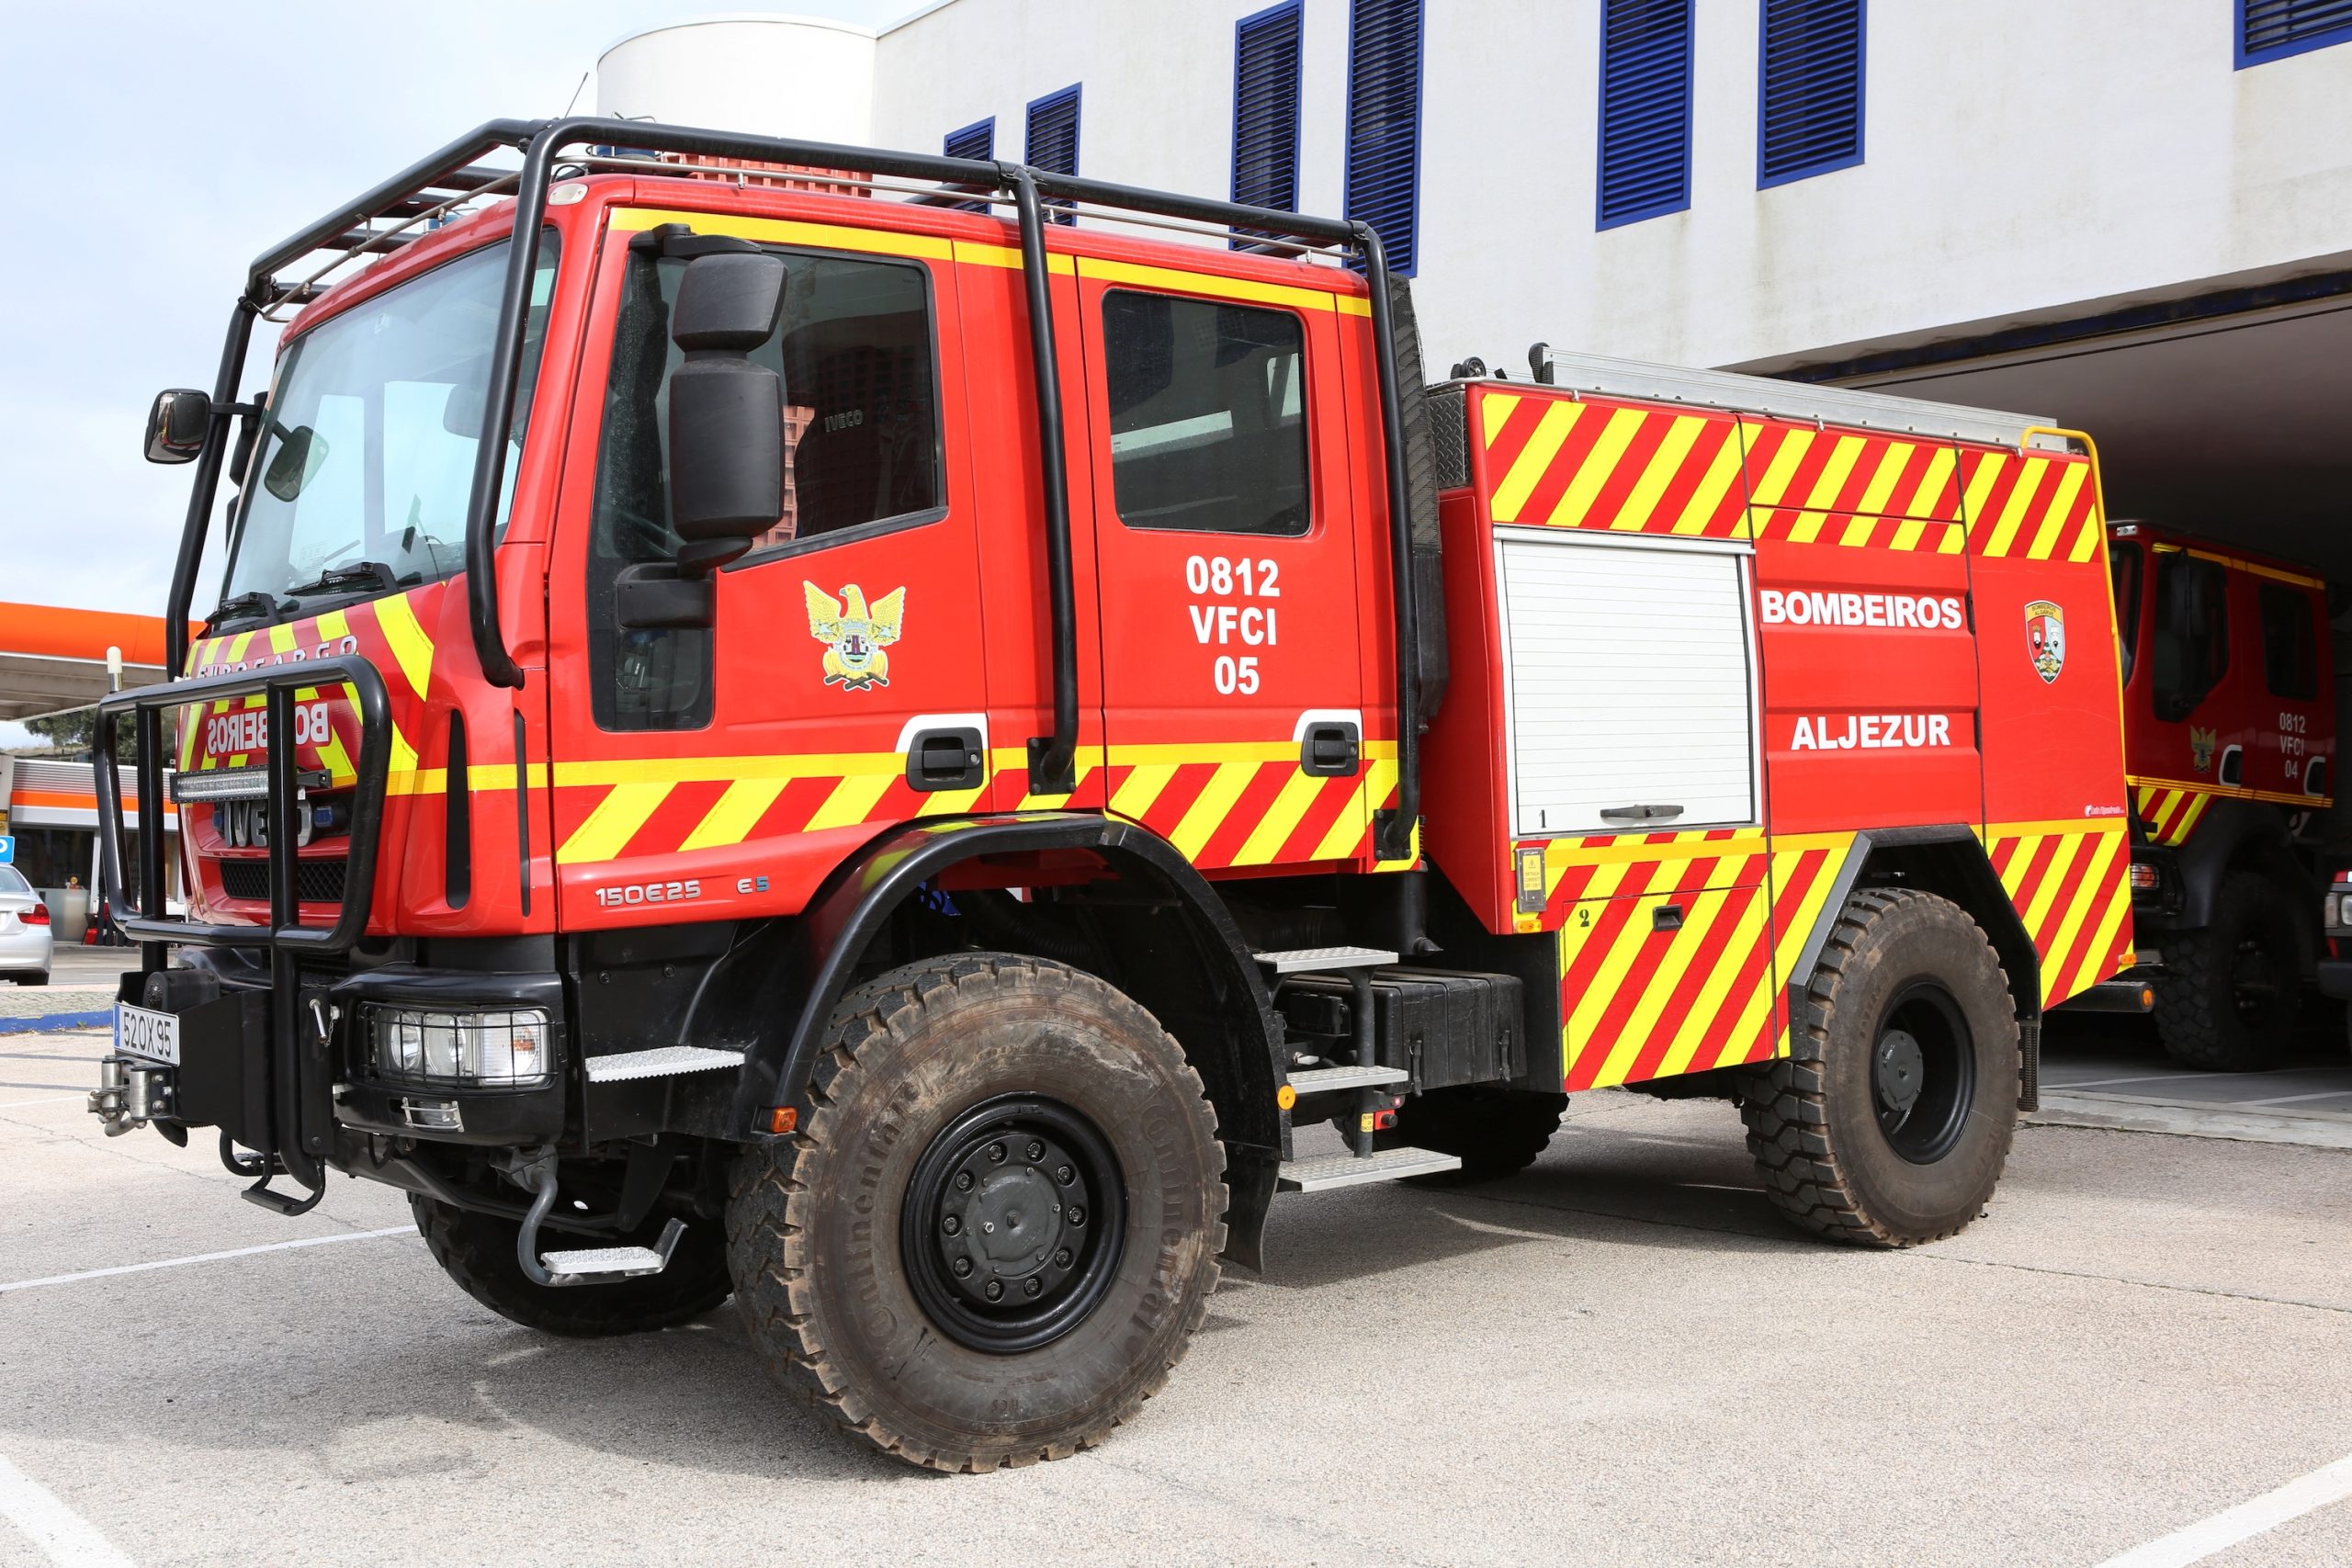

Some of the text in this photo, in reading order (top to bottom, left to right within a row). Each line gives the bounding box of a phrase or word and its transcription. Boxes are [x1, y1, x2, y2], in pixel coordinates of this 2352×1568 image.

[824, 409, 864, 433] IVECO
[1186, 555, 1281, 597] 0812
[1760, 590, 1962, 629] BOMBEIROS
[1188, 605, 1277, 646] VFCI
[1214, 655, 1261, 695] 05
[1791, 714, 1951, 750] ALJEZUR
[2279, 712, 2306, 734] 0812
[2280, 735, 2304, 757] VFCI
[2285, 760, 2298, 779] 04
[595, 880, 701, 907] 150E25
[1578, 909, 1590, 928] 2
